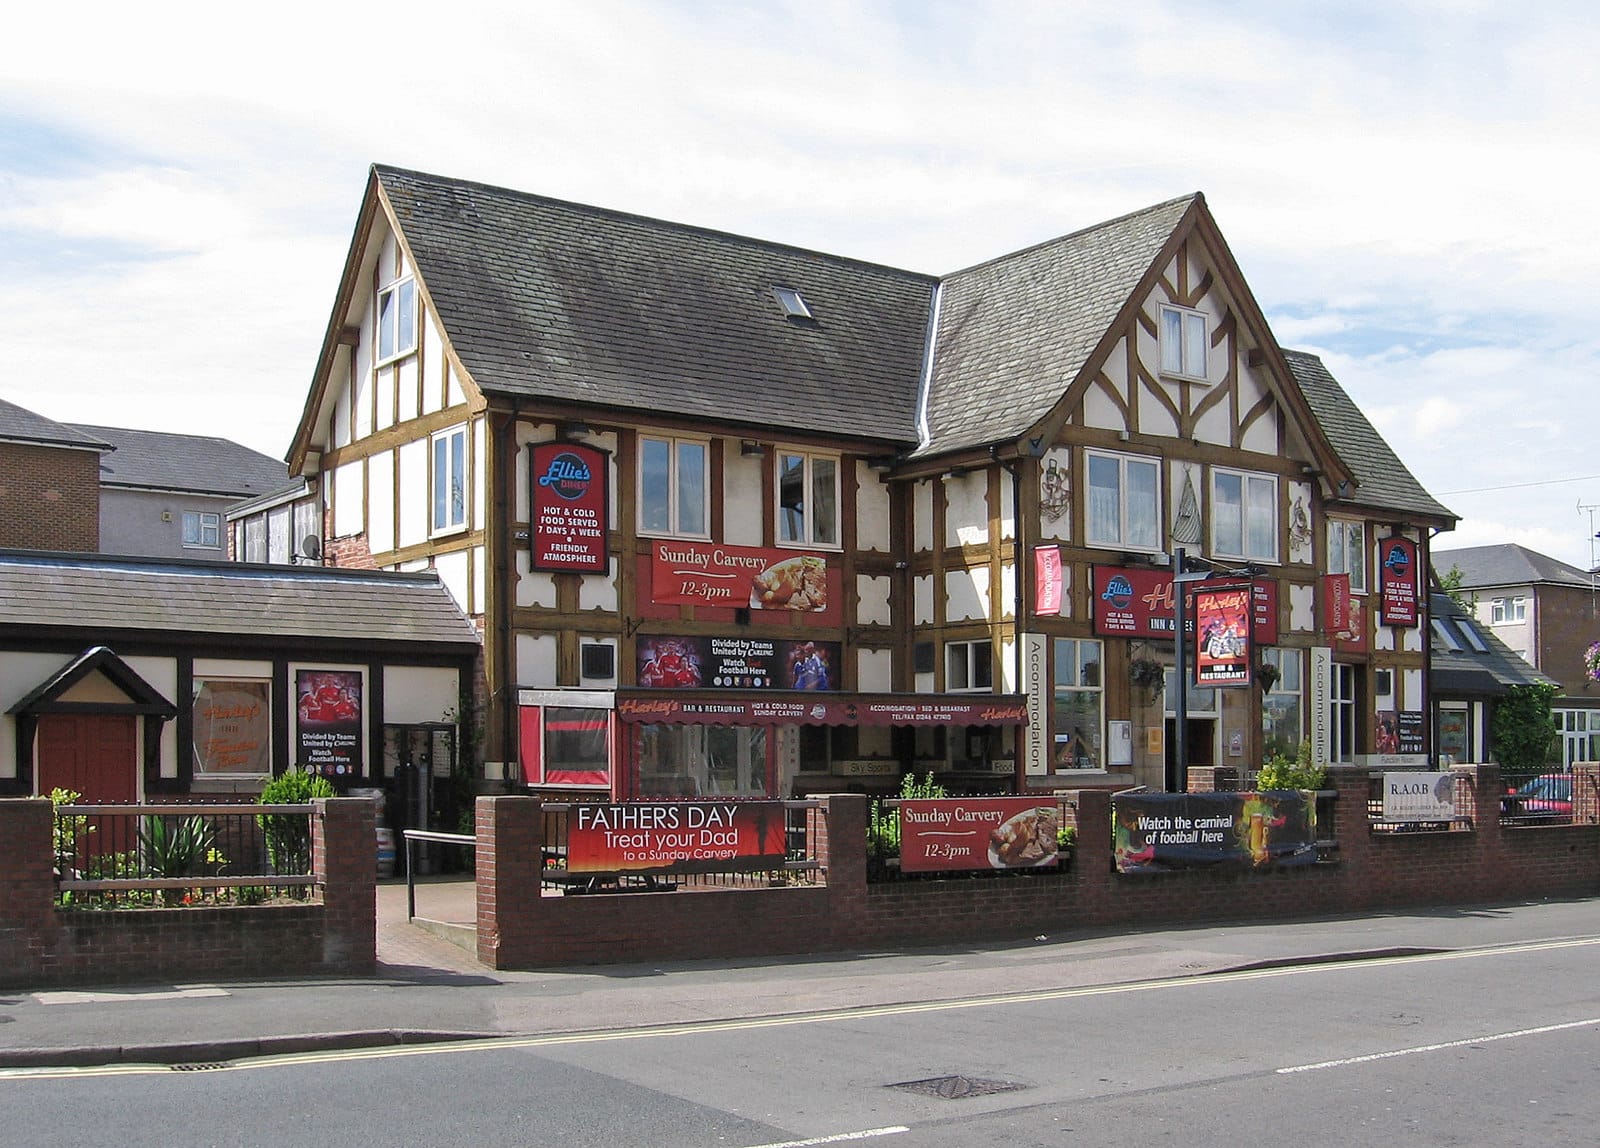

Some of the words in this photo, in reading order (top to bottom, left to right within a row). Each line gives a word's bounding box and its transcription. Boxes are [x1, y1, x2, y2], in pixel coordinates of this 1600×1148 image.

[539, 461, 591, 486] Ellie's
[543, 506, 561, 515] HOT
[564, 508, 570, 516] &
[573, 509, 595, 518] COLD
[541, 516, 565, 525] FOOD
[568, 518, 598, 527] SERVED
[538, 526, 543, 534] 7
[546, 526, 567, 535] DAYS
[571, 528, 577, 536] A
[579, 528, 601, 537] WEEK
[551, 543, 589, 553] FRIENDLY
[543, 553, 597, 563] ATMOSPHERE
[660, 545, 710, 569] Sunday
[713, 549, 767, 573] Carvery
[680, 581, 731, 600] 12-3pm
[1102, 581, 1133, 600] Ellie's
[1200, 592, 1247, 612] Harley's
[1150, 618, 1165, 630] INN
[711, 640, 740, 648] Divided
[741, 640, 749, 650] by
[750, 641, 773, 649] Teams
[738, 649, 747, 657] by
[719, 666, 748, 674] Football
[750, 667, 767, 675] Here
[1201, 672, 1245, 680] RESTAURANT
[619, 699, 678, 716] Harley's
[683, 704, 696, 712] BAR
[698, 704, 703, 712] &
[705, 705, 745, 713] RESTAURANT
[1031, 641, 1042, 768] Accommodation
[1317, 654, 1325, 763] Accommodation
[578, 806, 680, 830] FATHERS
[688, 806, 738, 829] DAY
[905, 808, 952, 826] Sunday
[954, 807, 1004, 825] Carvery
[1137, 816, 1171, 831] Watch
[1174, 816, 1192, 829] the
[1194, 814, 1233, 829] carnival
[604, 831, 650, 849] Treat
[655, 832, 695, 851] your
[700, 828, 738, 846] Dad
[1145, 831, 1157, 845] of
[1160, 830, 1198, 844] football
[1201, 830, 1224, 843] here
[623, 850, 635, 860] to
[638, 853, 646, 861] a
[649, 849, 690, 861] Sunday
[693, 848, 738, 860] Carvery
[924, 843, 970, 860] 12-3pm
